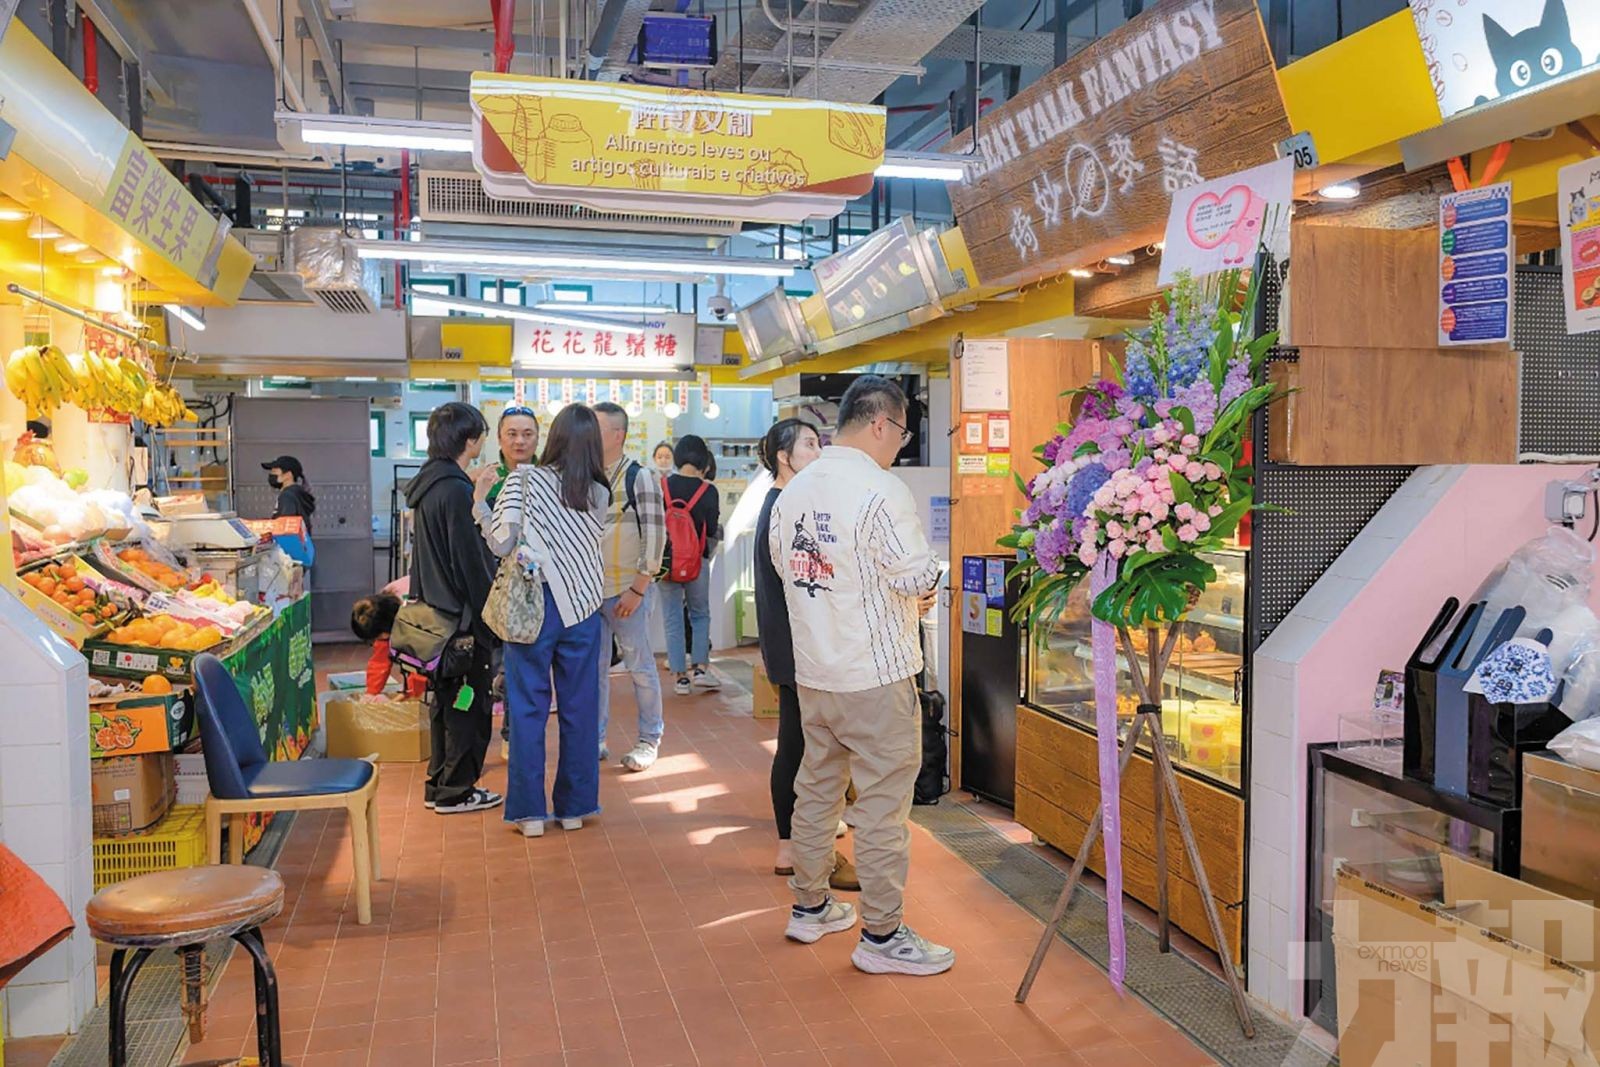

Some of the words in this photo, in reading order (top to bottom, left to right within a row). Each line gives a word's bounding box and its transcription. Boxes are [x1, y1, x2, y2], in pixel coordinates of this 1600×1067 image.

[1016, 79, 1086, 149] TALK
[1080, 0, 1223, 113] FANTASY
[605, 134, 697, 157] Alimentos
[700, 141, 745, 159] leves
[748, 148, 772, 162] ou
[1287, 146, 1313, 168] 05
[570, 157, 635, 179] artigos
[638, 160, 717, 181] culturais
[719, 168, 731, 181] e
[734, 164, 806, 188] criativos
[109, 148, 200, 262] 富榮生果
